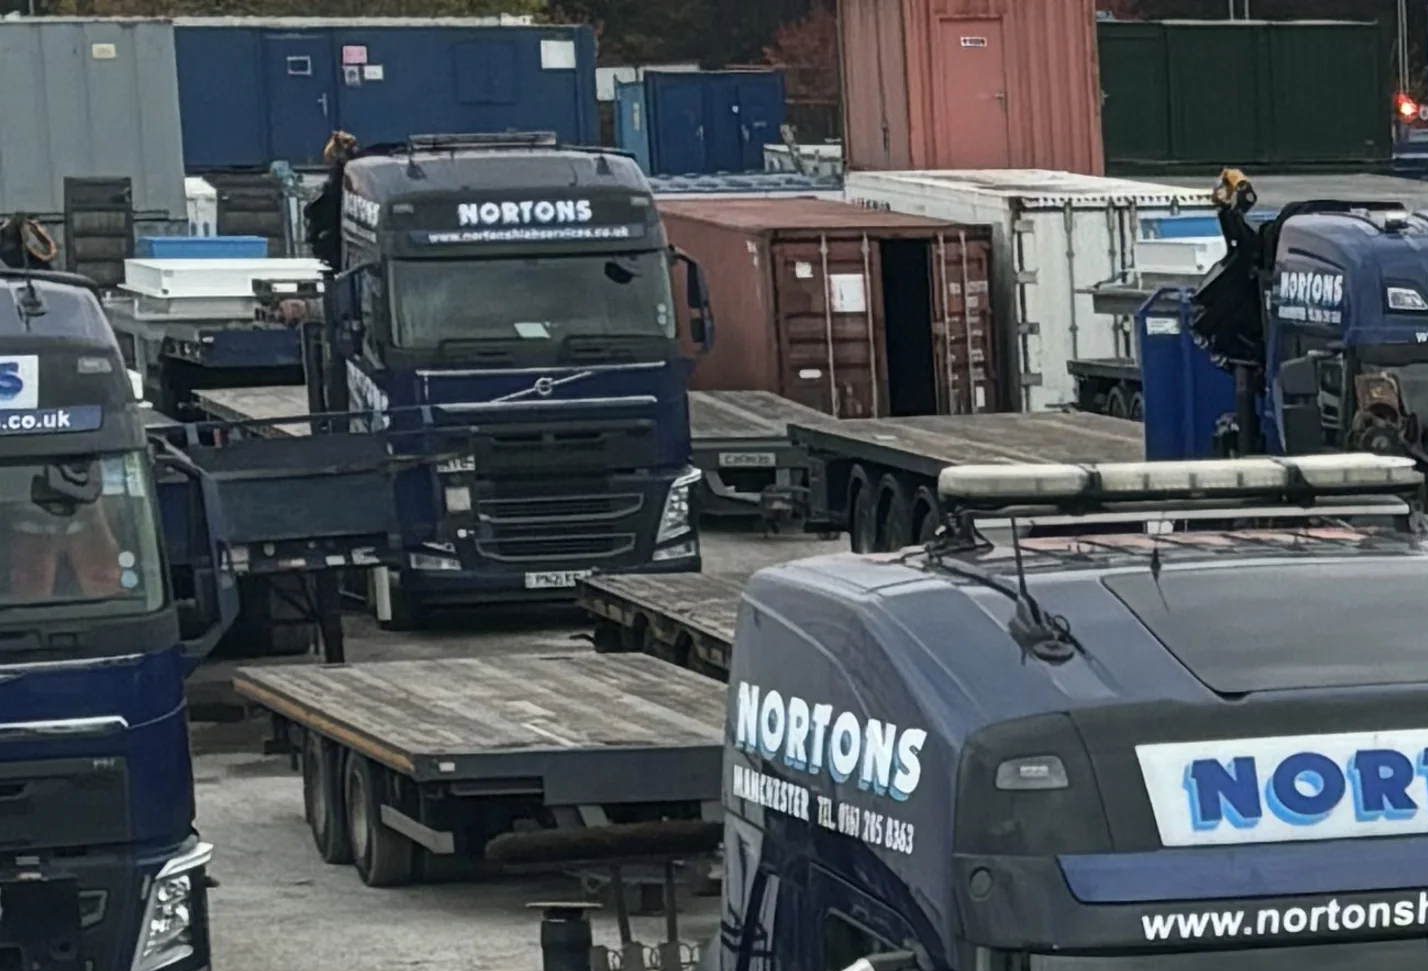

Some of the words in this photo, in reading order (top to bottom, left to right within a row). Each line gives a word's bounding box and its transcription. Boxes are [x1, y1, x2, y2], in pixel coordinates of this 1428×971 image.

[458, 200, 592, 226] NORTONS
[1280, 272, 1343, 306] NORTONS
[734, 681, 928, 802] NORTONS
[733, 764, 809, 822] MANCHESTER
[885, 817, 915, 854] 8363
